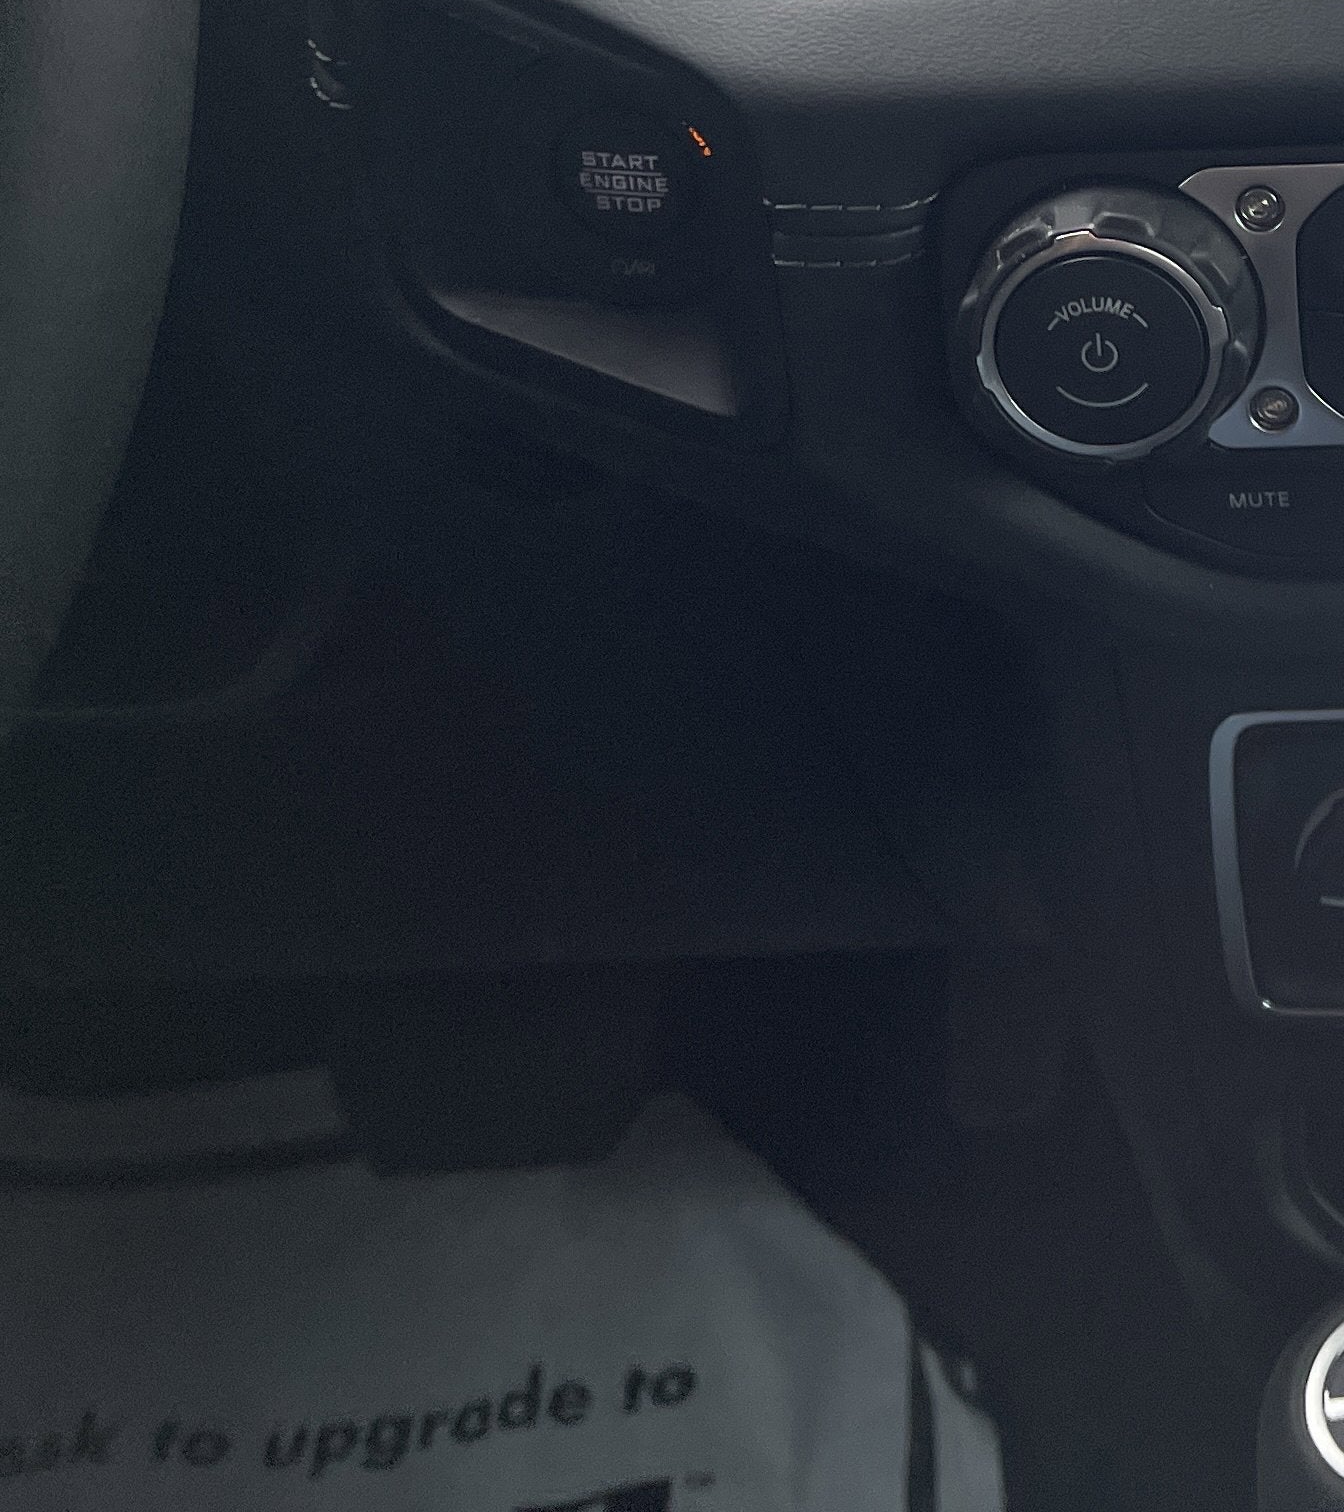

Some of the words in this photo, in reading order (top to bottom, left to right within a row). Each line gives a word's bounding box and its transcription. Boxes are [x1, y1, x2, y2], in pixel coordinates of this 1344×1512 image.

[581, 150, 659, 170] START
[578, 172, 669, 193] ENGINE
[596, 194, 662, 213] STOP
[1055, 294, 1136, 323] VOLUME
[1229, 490, 1290, 509] MUTE
[152, 1419, 231, 1468] to
[261, 1361, 593, 1483] upgrade
[621, 1361, 698, 1415] to
